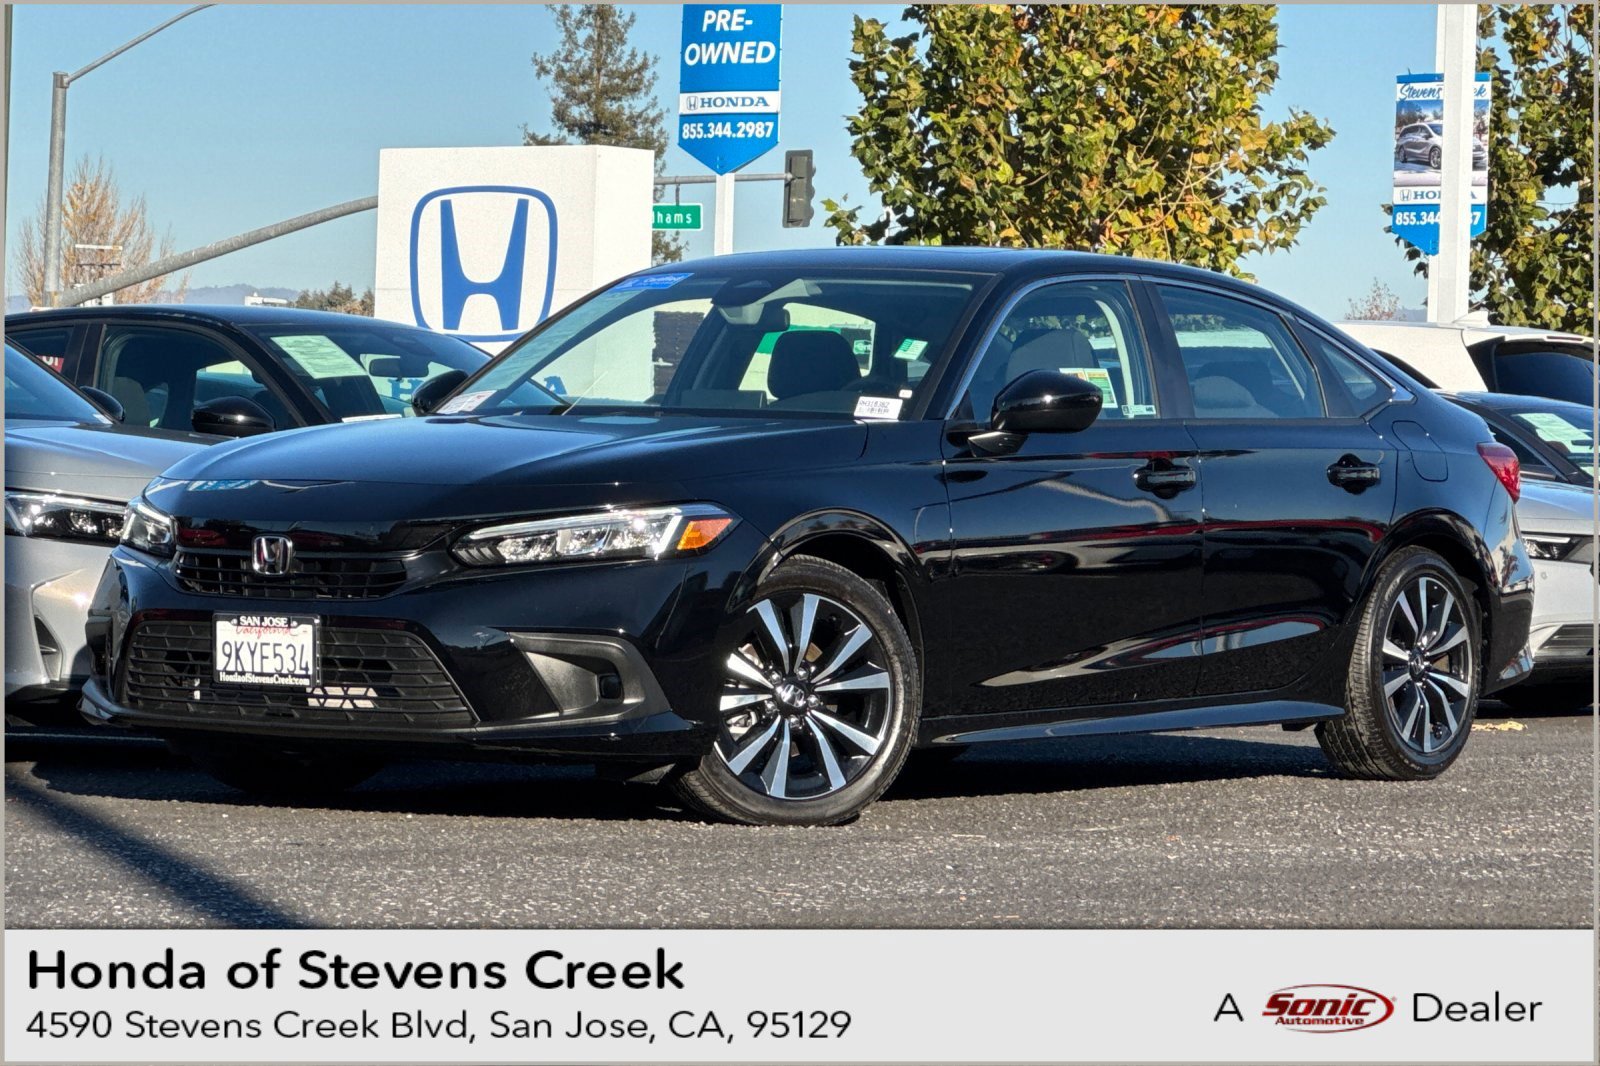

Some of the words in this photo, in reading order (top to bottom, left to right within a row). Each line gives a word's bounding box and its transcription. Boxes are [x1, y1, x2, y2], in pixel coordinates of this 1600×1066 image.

[702, 9, 753, 32] PRE-
[684, 41, 776, 66] OWNED
[1399, 83, 1442, 100] Stevens
[700, 96, 770, 109] HONDA
[682, 121, 774, 139] 855.344.2987
[239, 615, 260, 626] SAN
[262, 616, 288, 627] JOSE
[222, 640, 310, 674] 9KYF534
